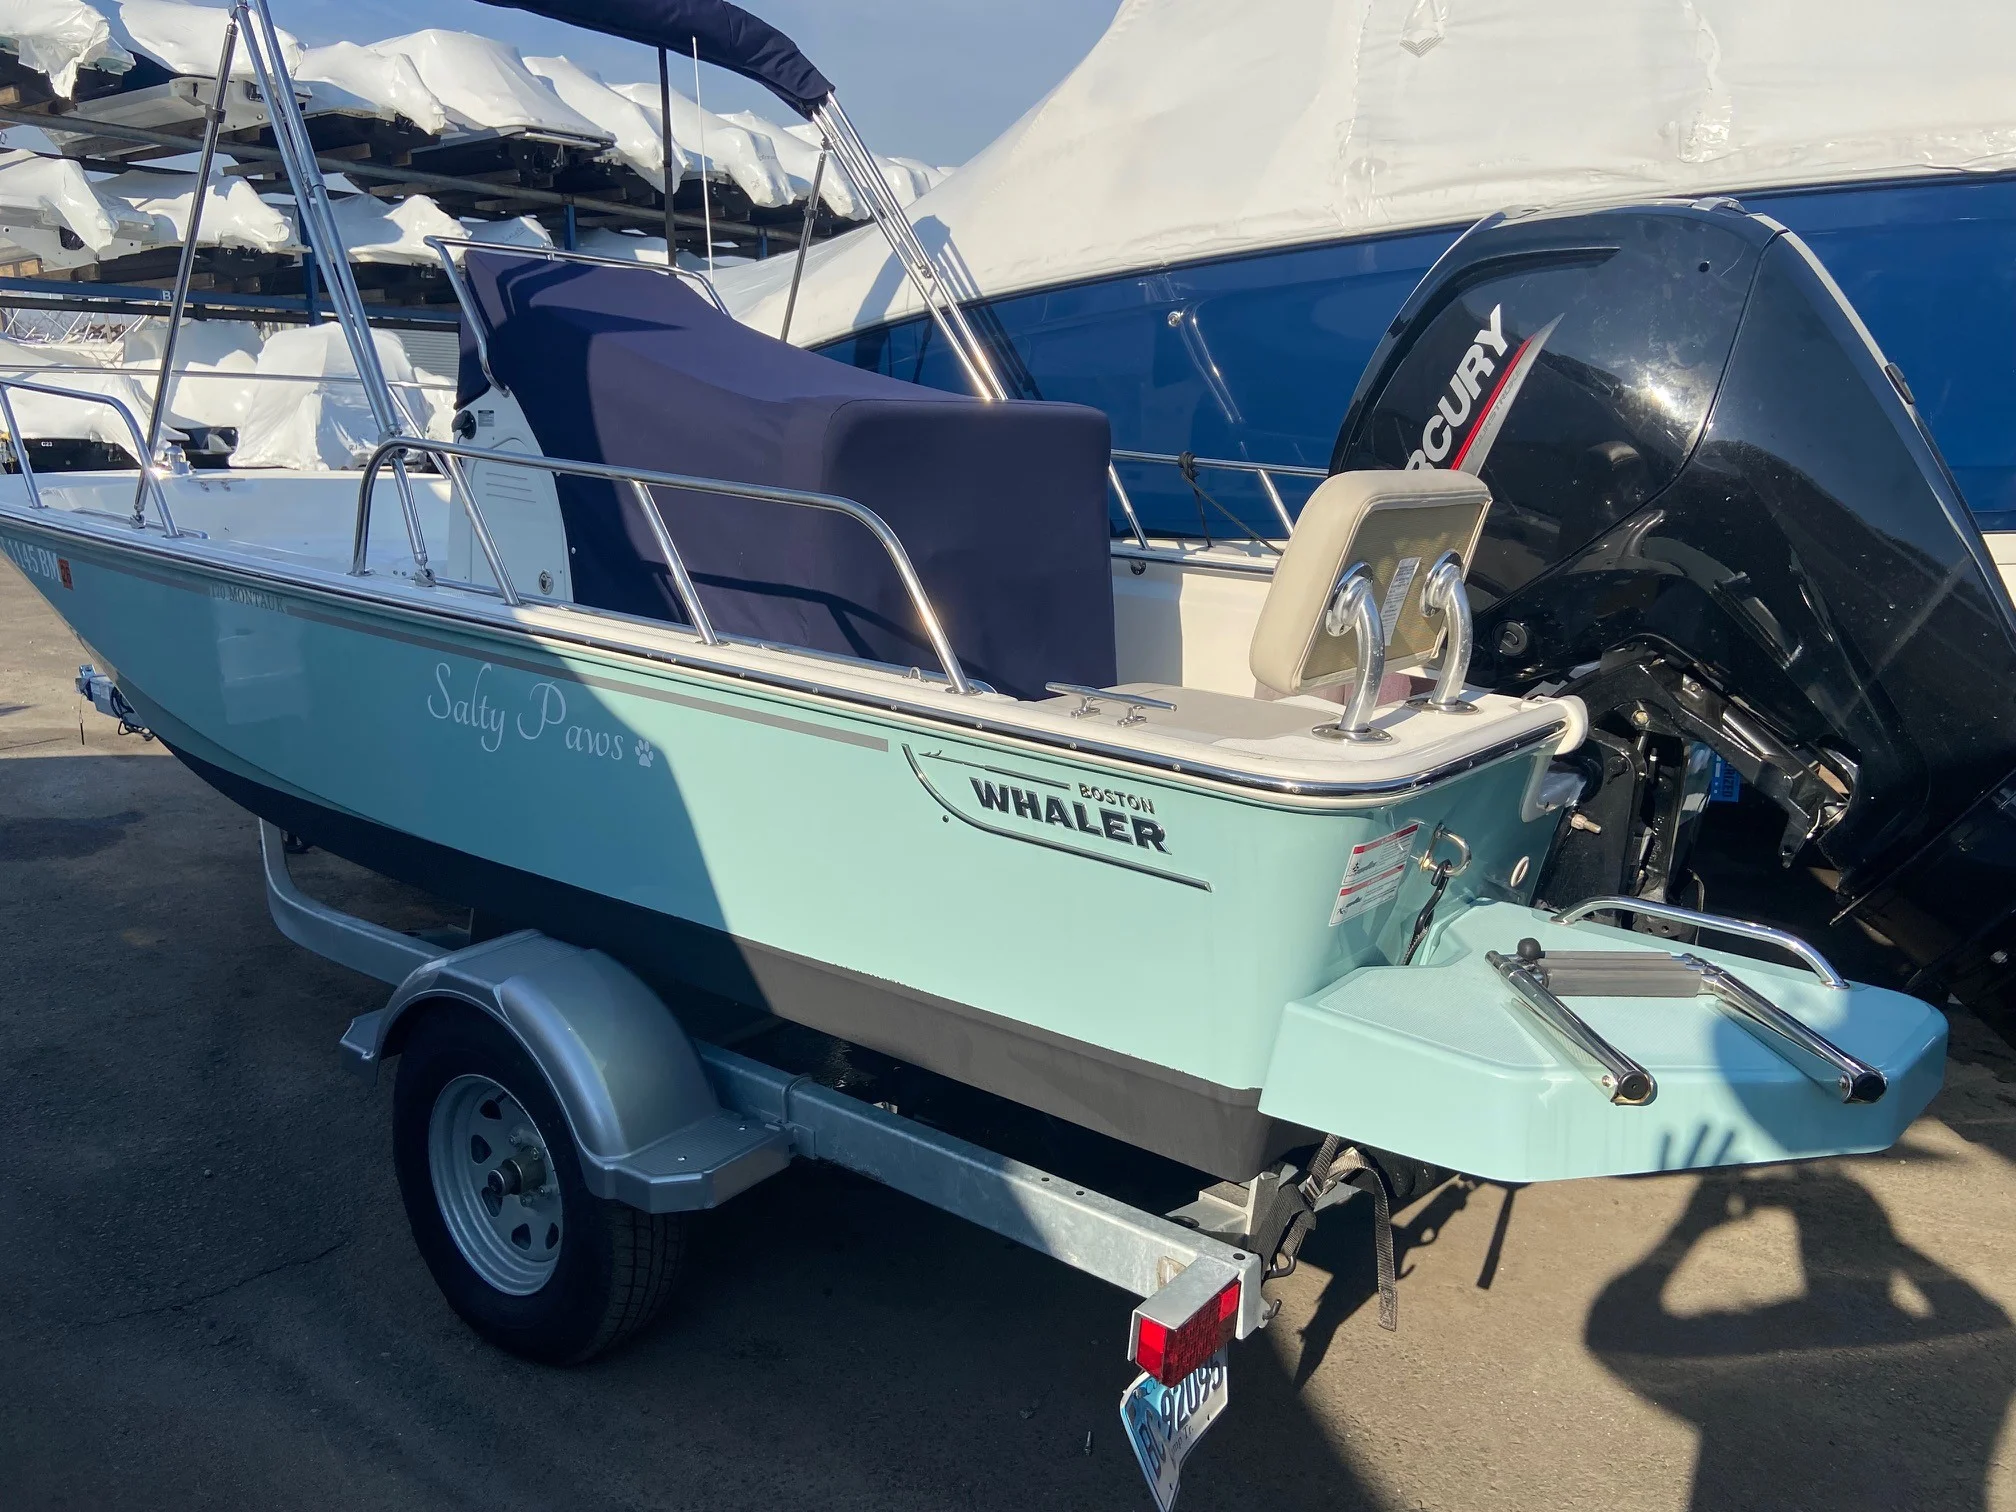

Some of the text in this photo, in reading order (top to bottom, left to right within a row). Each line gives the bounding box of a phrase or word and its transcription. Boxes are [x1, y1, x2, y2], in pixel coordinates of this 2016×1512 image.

[1470, 367, 1523, 457] FOURSTROKE
[229, 586, 286, 614] MONTAUK
[428, 662, 624, 761] Salty Paws
[969, 777, 1173, 855] WHALER
[1078, 782, 1155, 815] BOSTON
